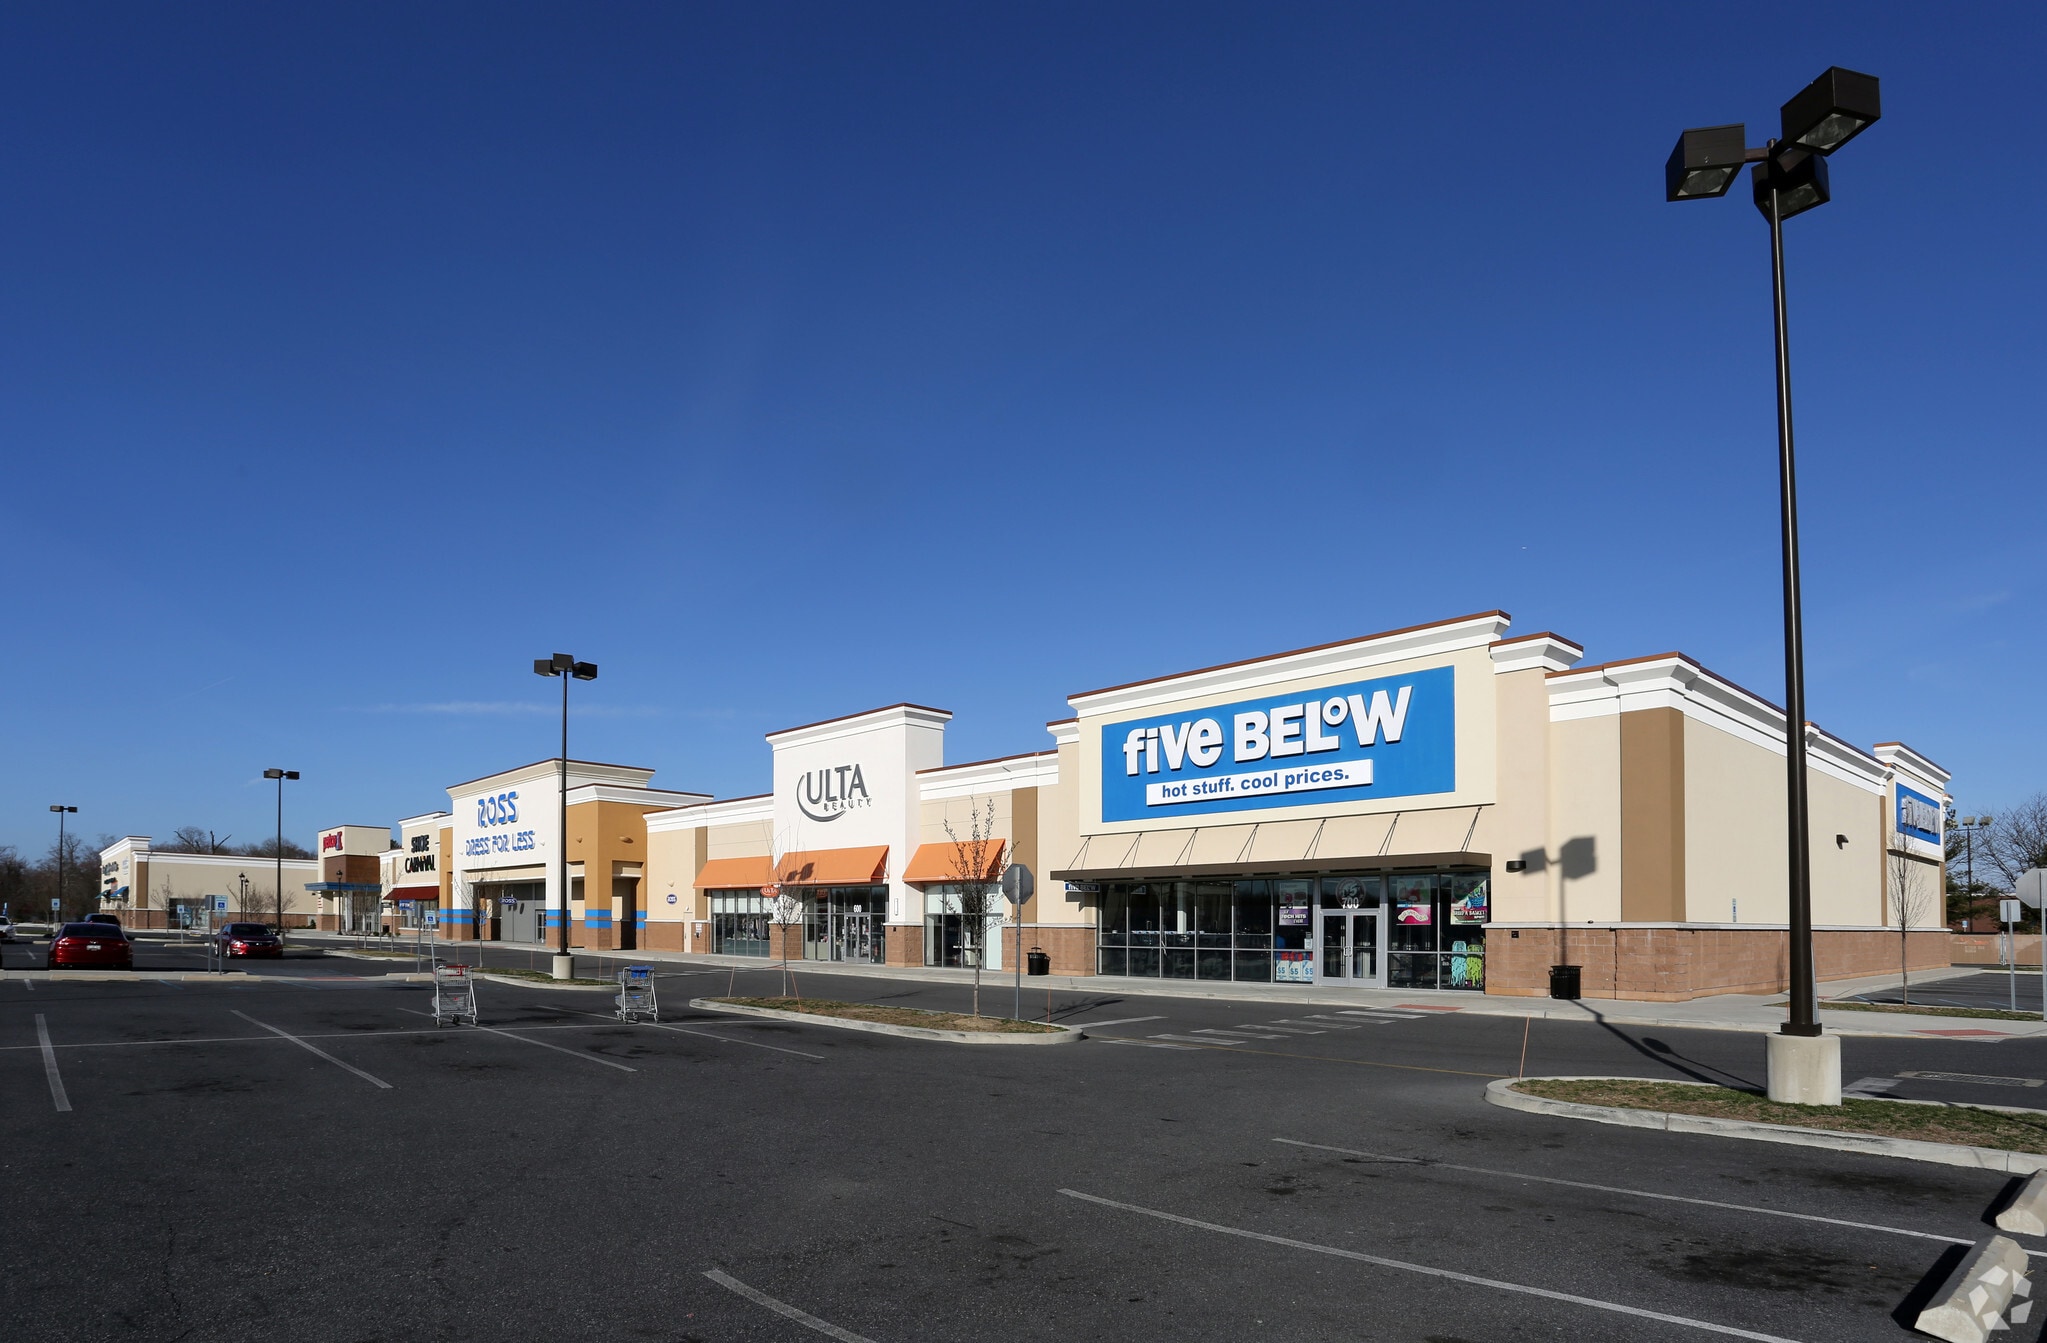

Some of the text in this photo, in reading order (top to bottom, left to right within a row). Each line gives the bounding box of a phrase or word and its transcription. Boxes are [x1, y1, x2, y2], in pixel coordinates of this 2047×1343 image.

[1123, 718, 1224, 776] five
[806, 763, 868, 805] ULTA
[1162, 766, 1350, 798] hot stuff. cool prices.
[477, 791, 518, 828] ROSS
[823, 798, 872, 812] BEAUTY
[411, 834, 430, 854] SHOE
[465, 830, 536, 856] DRESS FOR LESS
[853, 904, 862, 913] 600
[1341, 897, 1360, 910] 700
[1305, 967, 1314, 975] $5
